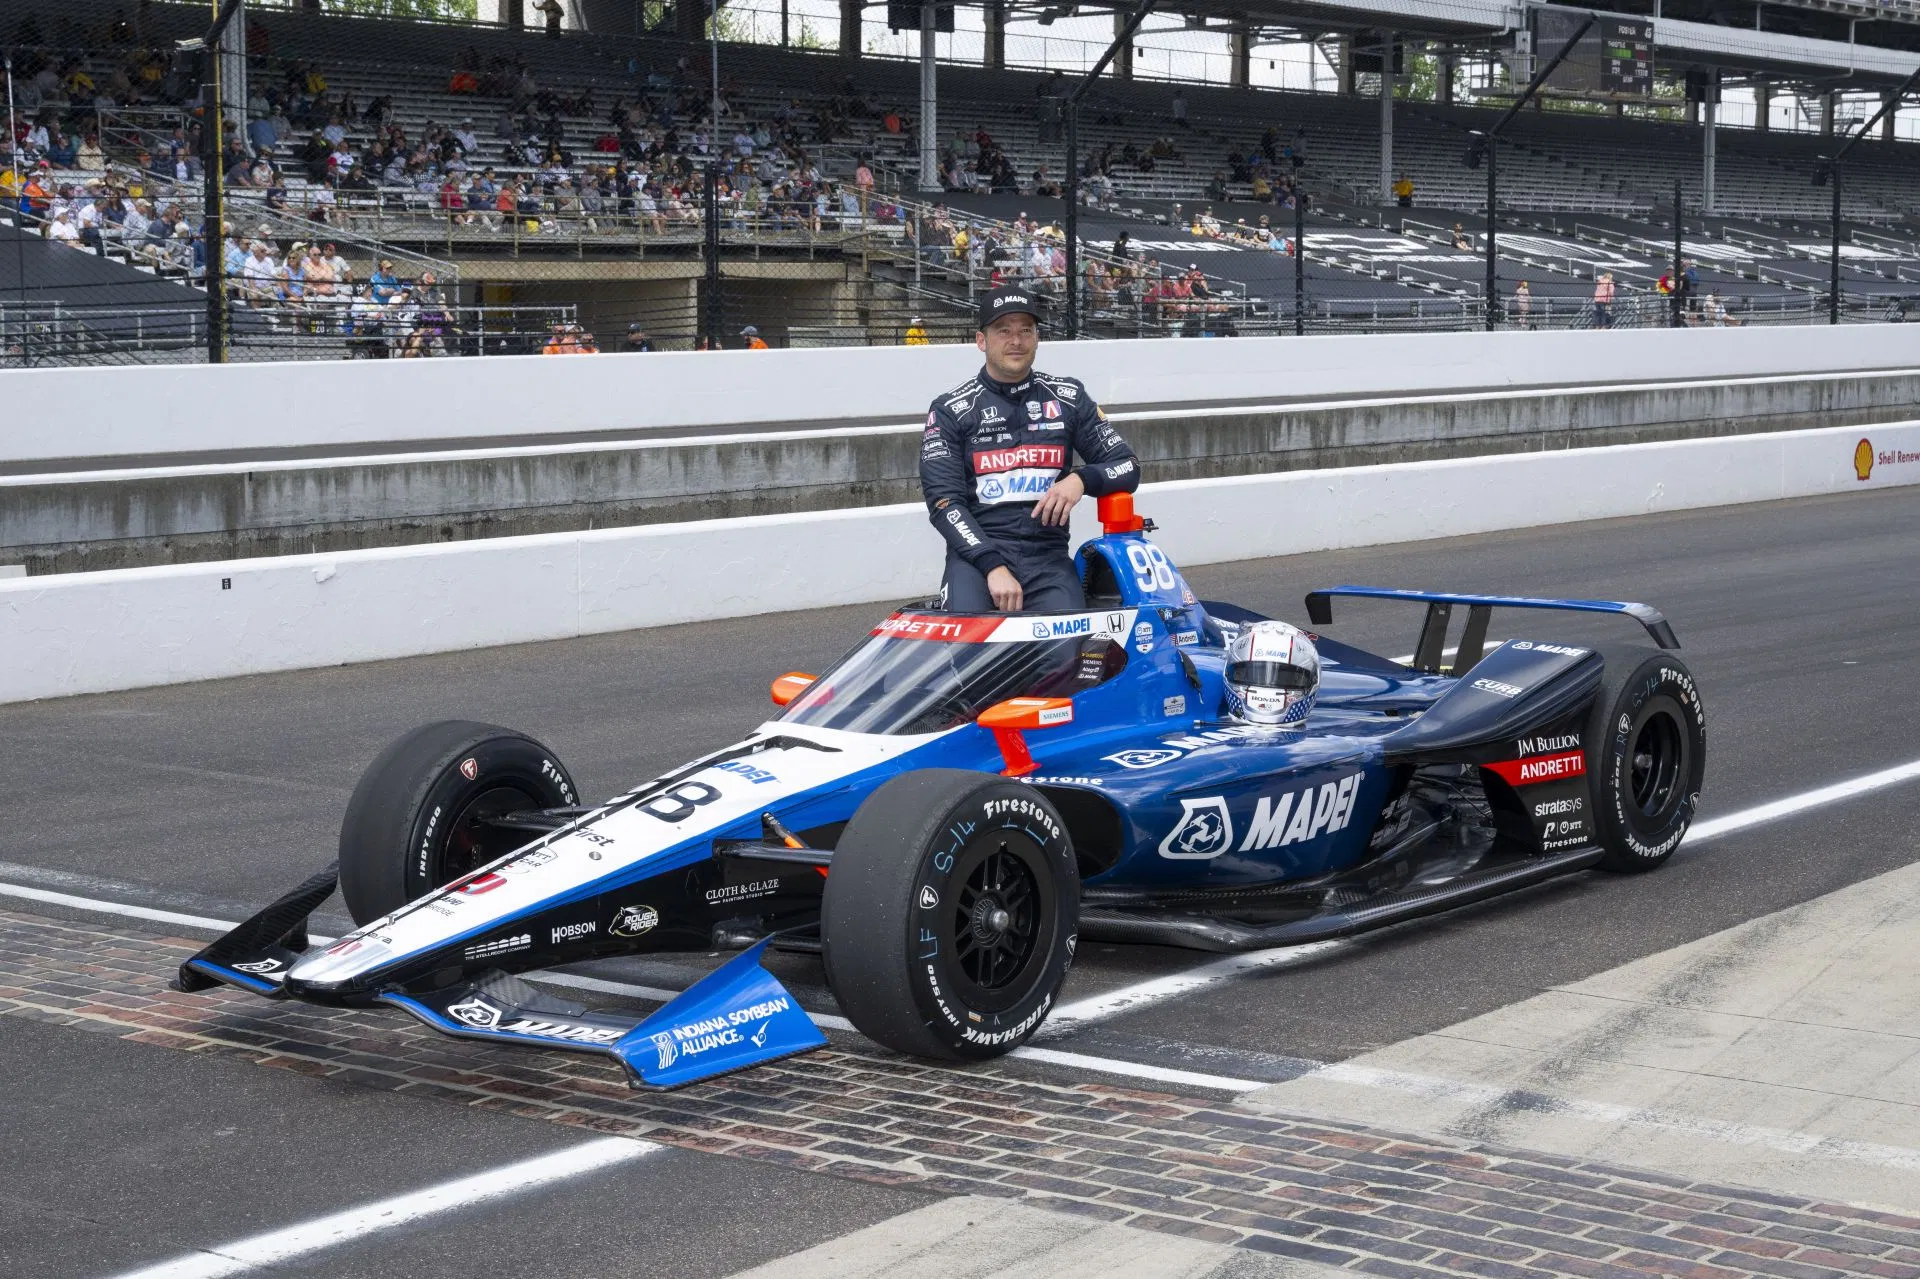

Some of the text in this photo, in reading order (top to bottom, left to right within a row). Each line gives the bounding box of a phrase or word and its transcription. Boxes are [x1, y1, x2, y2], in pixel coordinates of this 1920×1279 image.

[980, 448, 1062, 470] ANDRETTI
[1878, 450, 1896, 465] Shell
[1127, 544, 1175, 593] 98
[1053, 618, 1091, 636] MAPEI
[1265, 650, 1287, 659] MAPEI
[1533, 644, 1585, 657] MAPEI
[1473, 678, 1523, 695] CURB
[1660, 667, 1705, 725] Firestone
[1043, 711, 1069, 720] SIEMENS
[1518, 733, 1580, 759] JM BULLION
[1520, 756, 1582, 780] ANDRETTI
[541, 759, 577, 807] Fires
[635, 781, 722, 823] 8
[1238, 771, 1362, 852] MAPEI
[1535, 797, 1582, 816] stratasys
[983, 798, 1060, 839] Firestone
[1543, 835, 1588, 850] Firestone
[1625, 821, 1686, 858] FIREHAWK
[706, 878, 779, 900] CLOTH & GLAZE
[624, 911, 658, 925] ROUGH
[630, 918, 658, 932] RIDER
[551, 921, 596, 944] HOBSON
[673, 997, 789, 1042] INDIANA SOYBEAN
[960, 992, 1051, 1045] FIREHAWK
